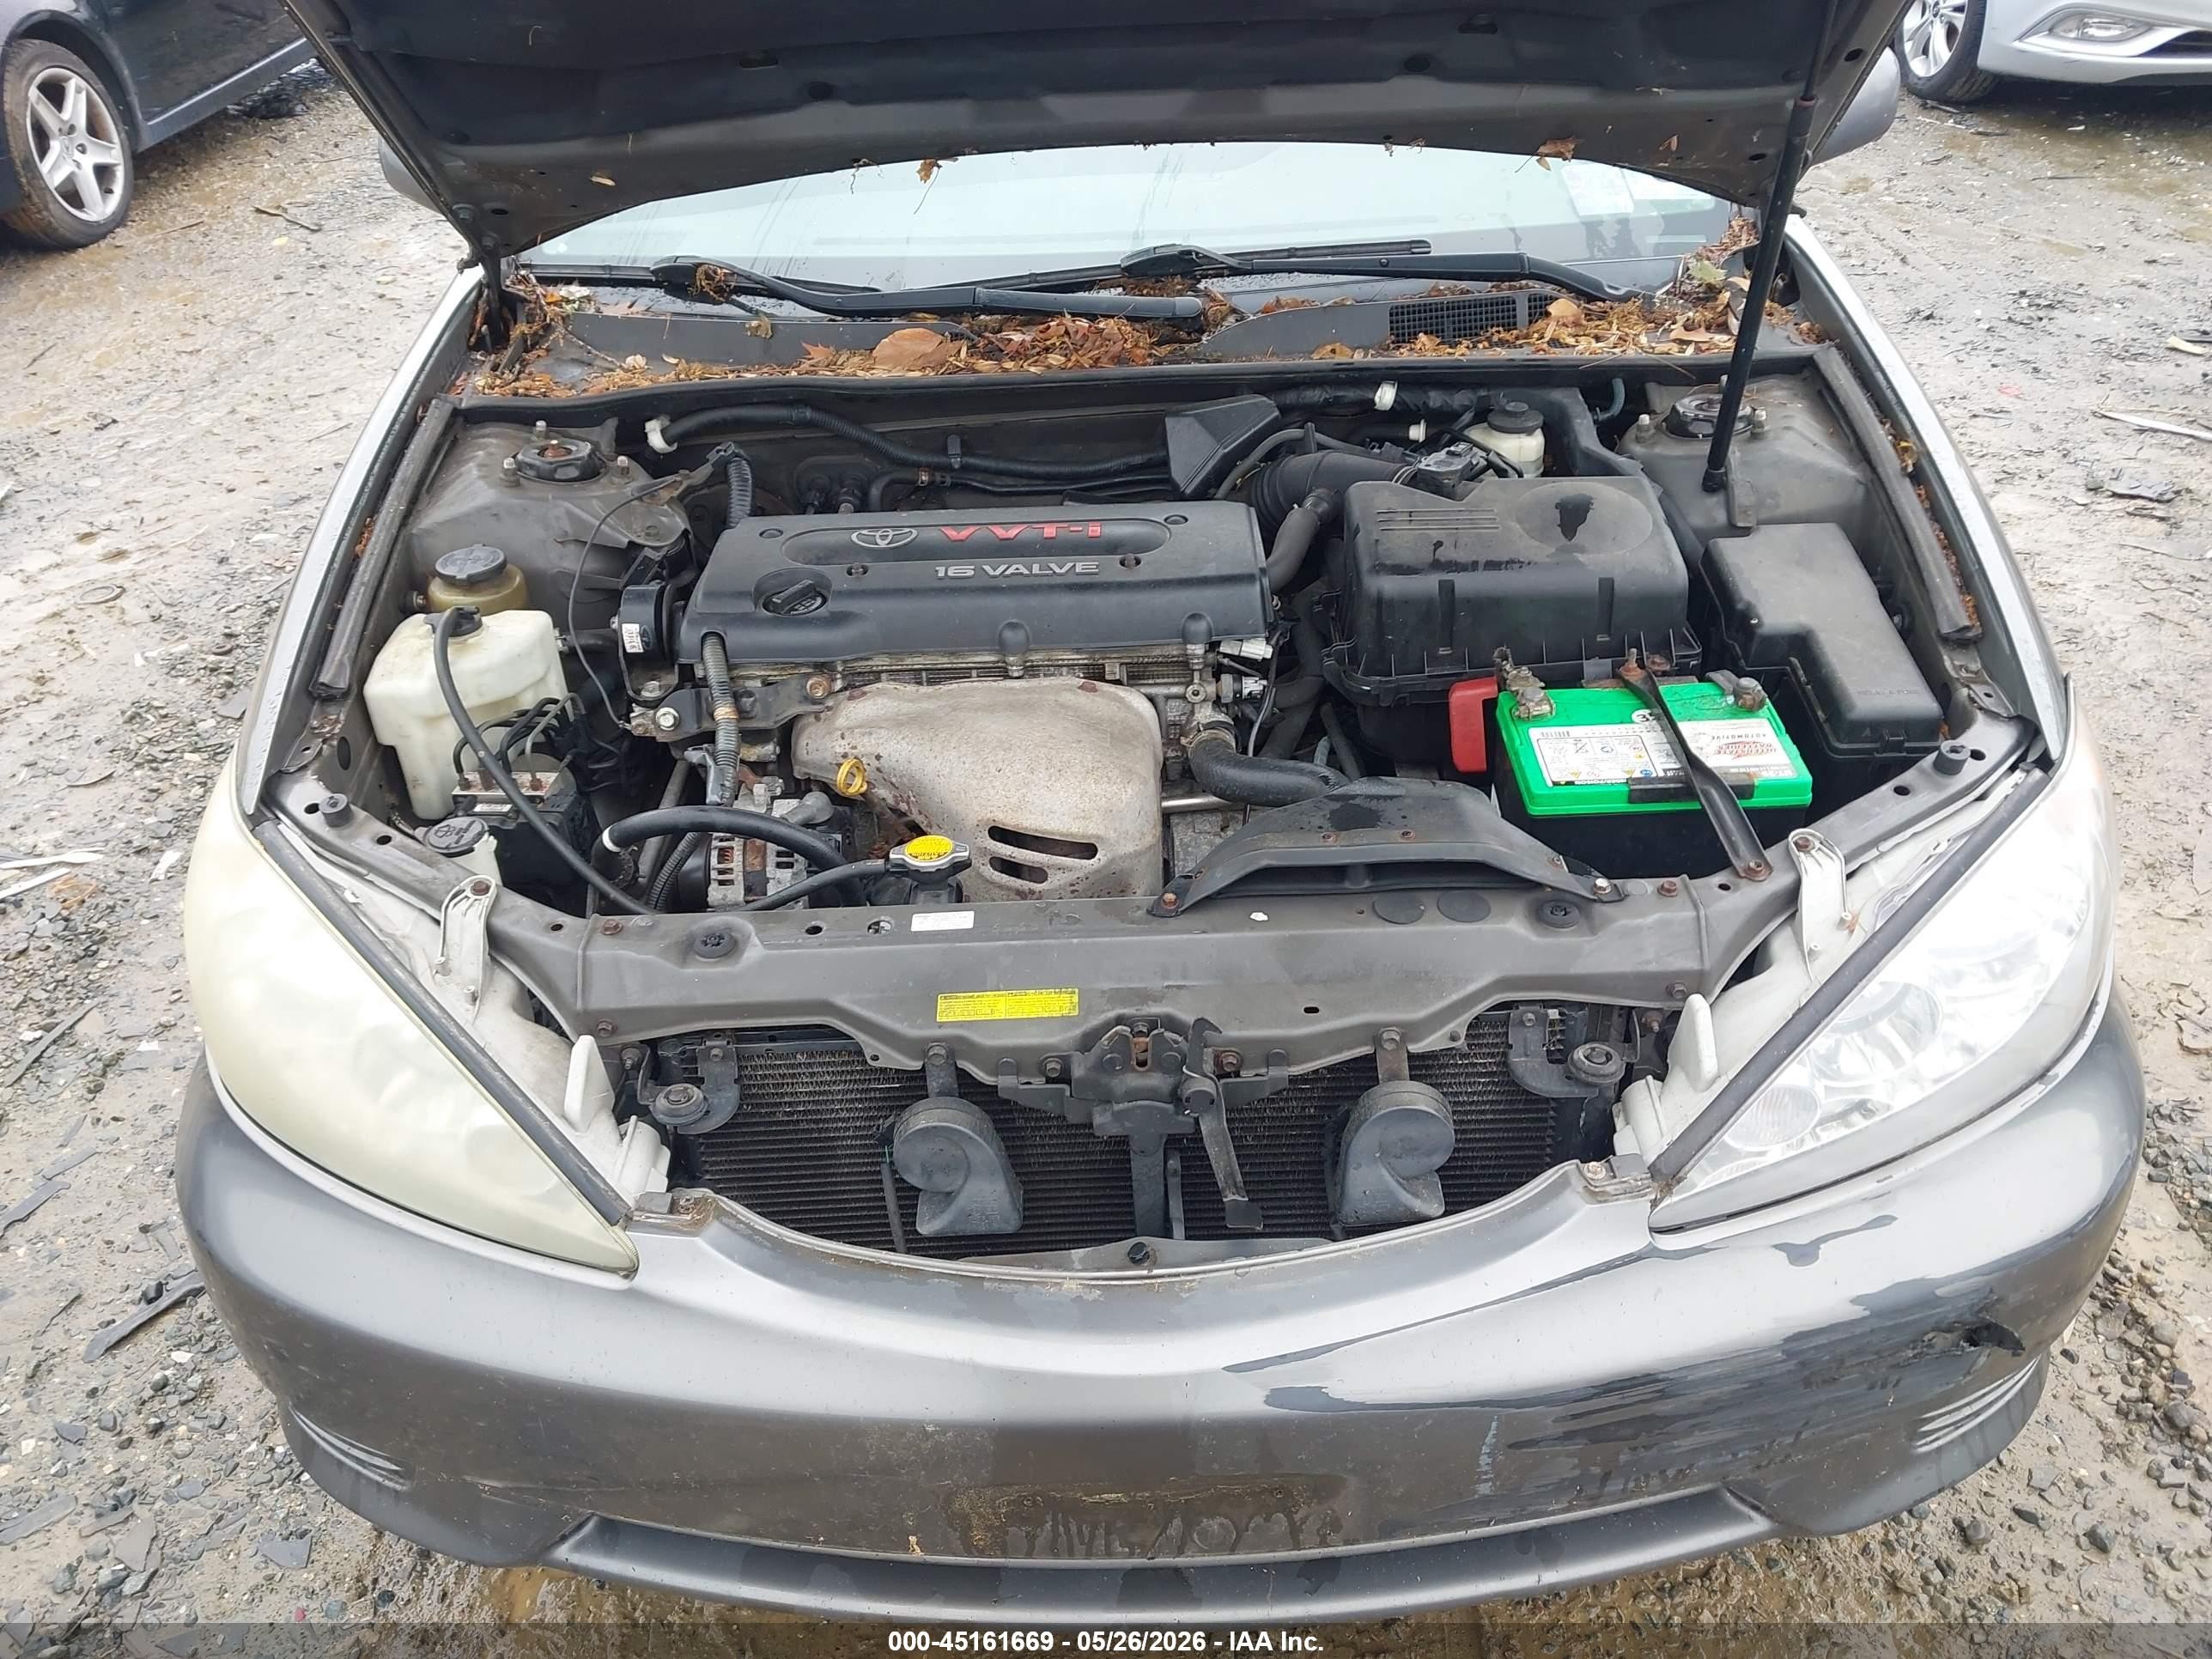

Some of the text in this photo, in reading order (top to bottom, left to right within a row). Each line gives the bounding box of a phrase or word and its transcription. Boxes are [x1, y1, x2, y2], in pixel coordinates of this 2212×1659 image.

[939, 521, 1102, 542] VVT-i
[935, 561, 1100, 580] 16 VALVE
